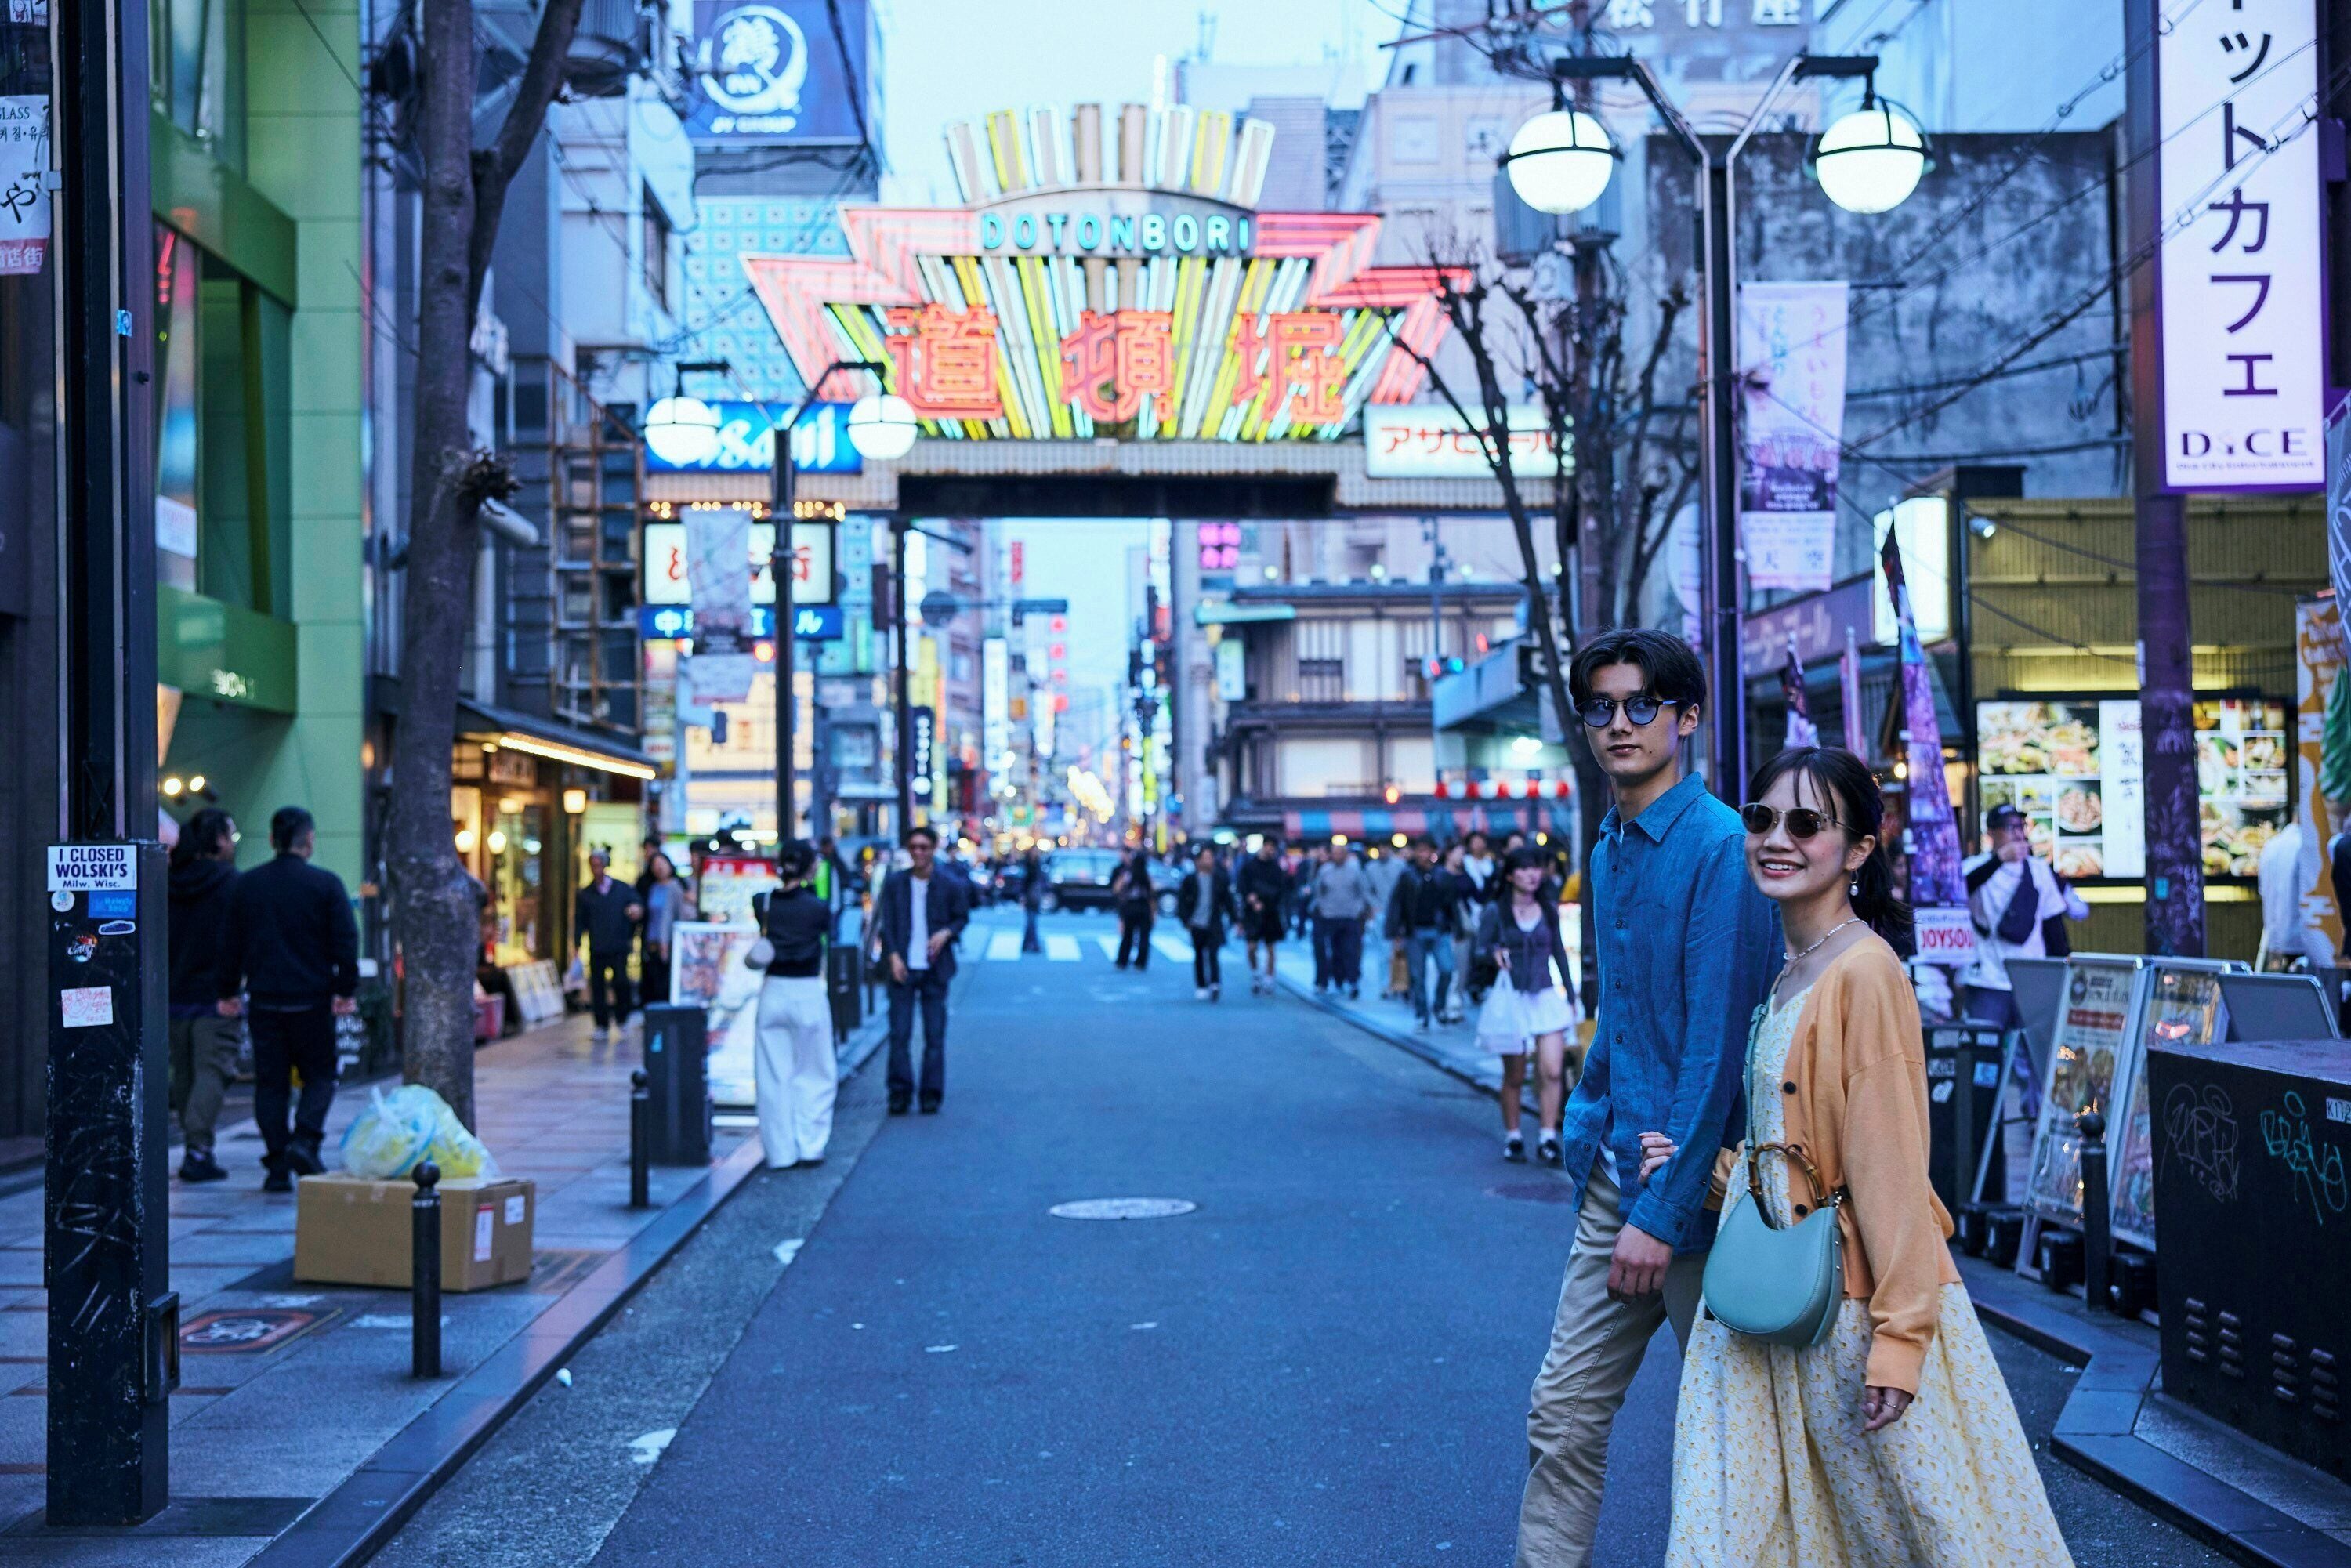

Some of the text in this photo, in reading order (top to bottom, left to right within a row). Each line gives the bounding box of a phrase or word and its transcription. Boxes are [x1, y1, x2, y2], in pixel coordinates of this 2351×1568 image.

[0, 106, 30, 120] LASS
[2209, 0, 2279, 396] ットカフェ
[981, 213, 1249, 252] DOTONBORI
[884, 302, 1346, 423] 道頓堀
[60, 848, 125, 862] I CLOSED
[56, 864, 128, 878] WOLSKI'S
